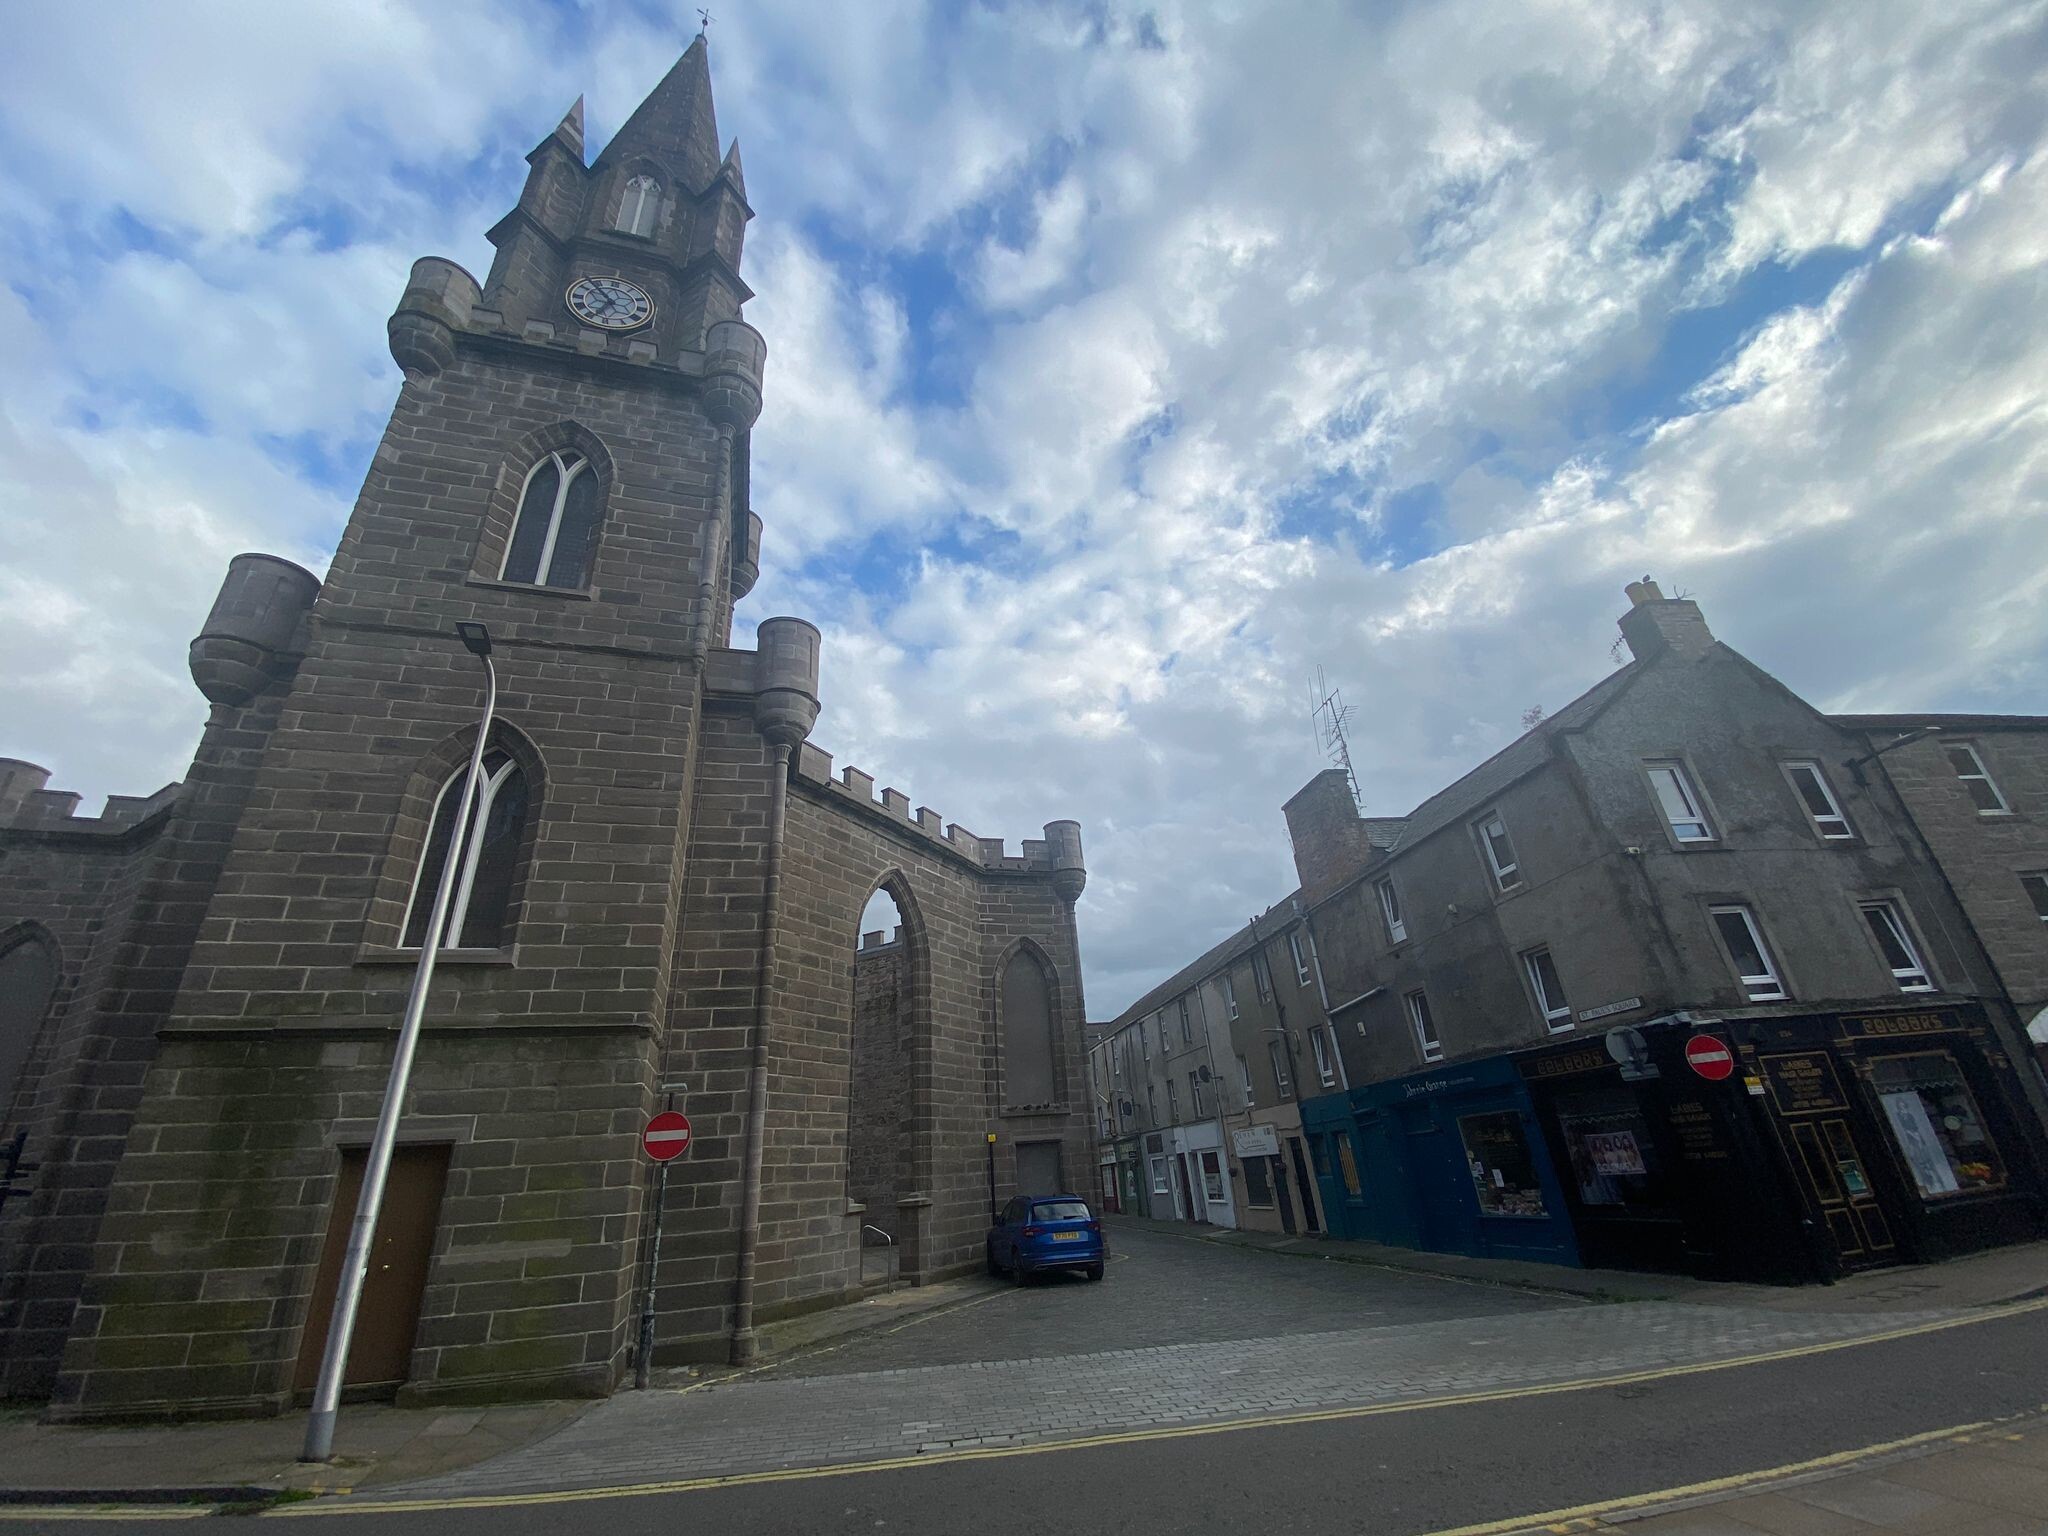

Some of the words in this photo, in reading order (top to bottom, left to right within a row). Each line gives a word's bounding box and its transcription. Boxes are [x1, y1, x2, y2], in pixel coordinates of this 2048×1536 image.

[1612, 998, 1639, 1012] SQUARE
[1862, 1014, 1943, 1034] COLOURS
[1537, 1050, 1604, 1075] COLOURS
